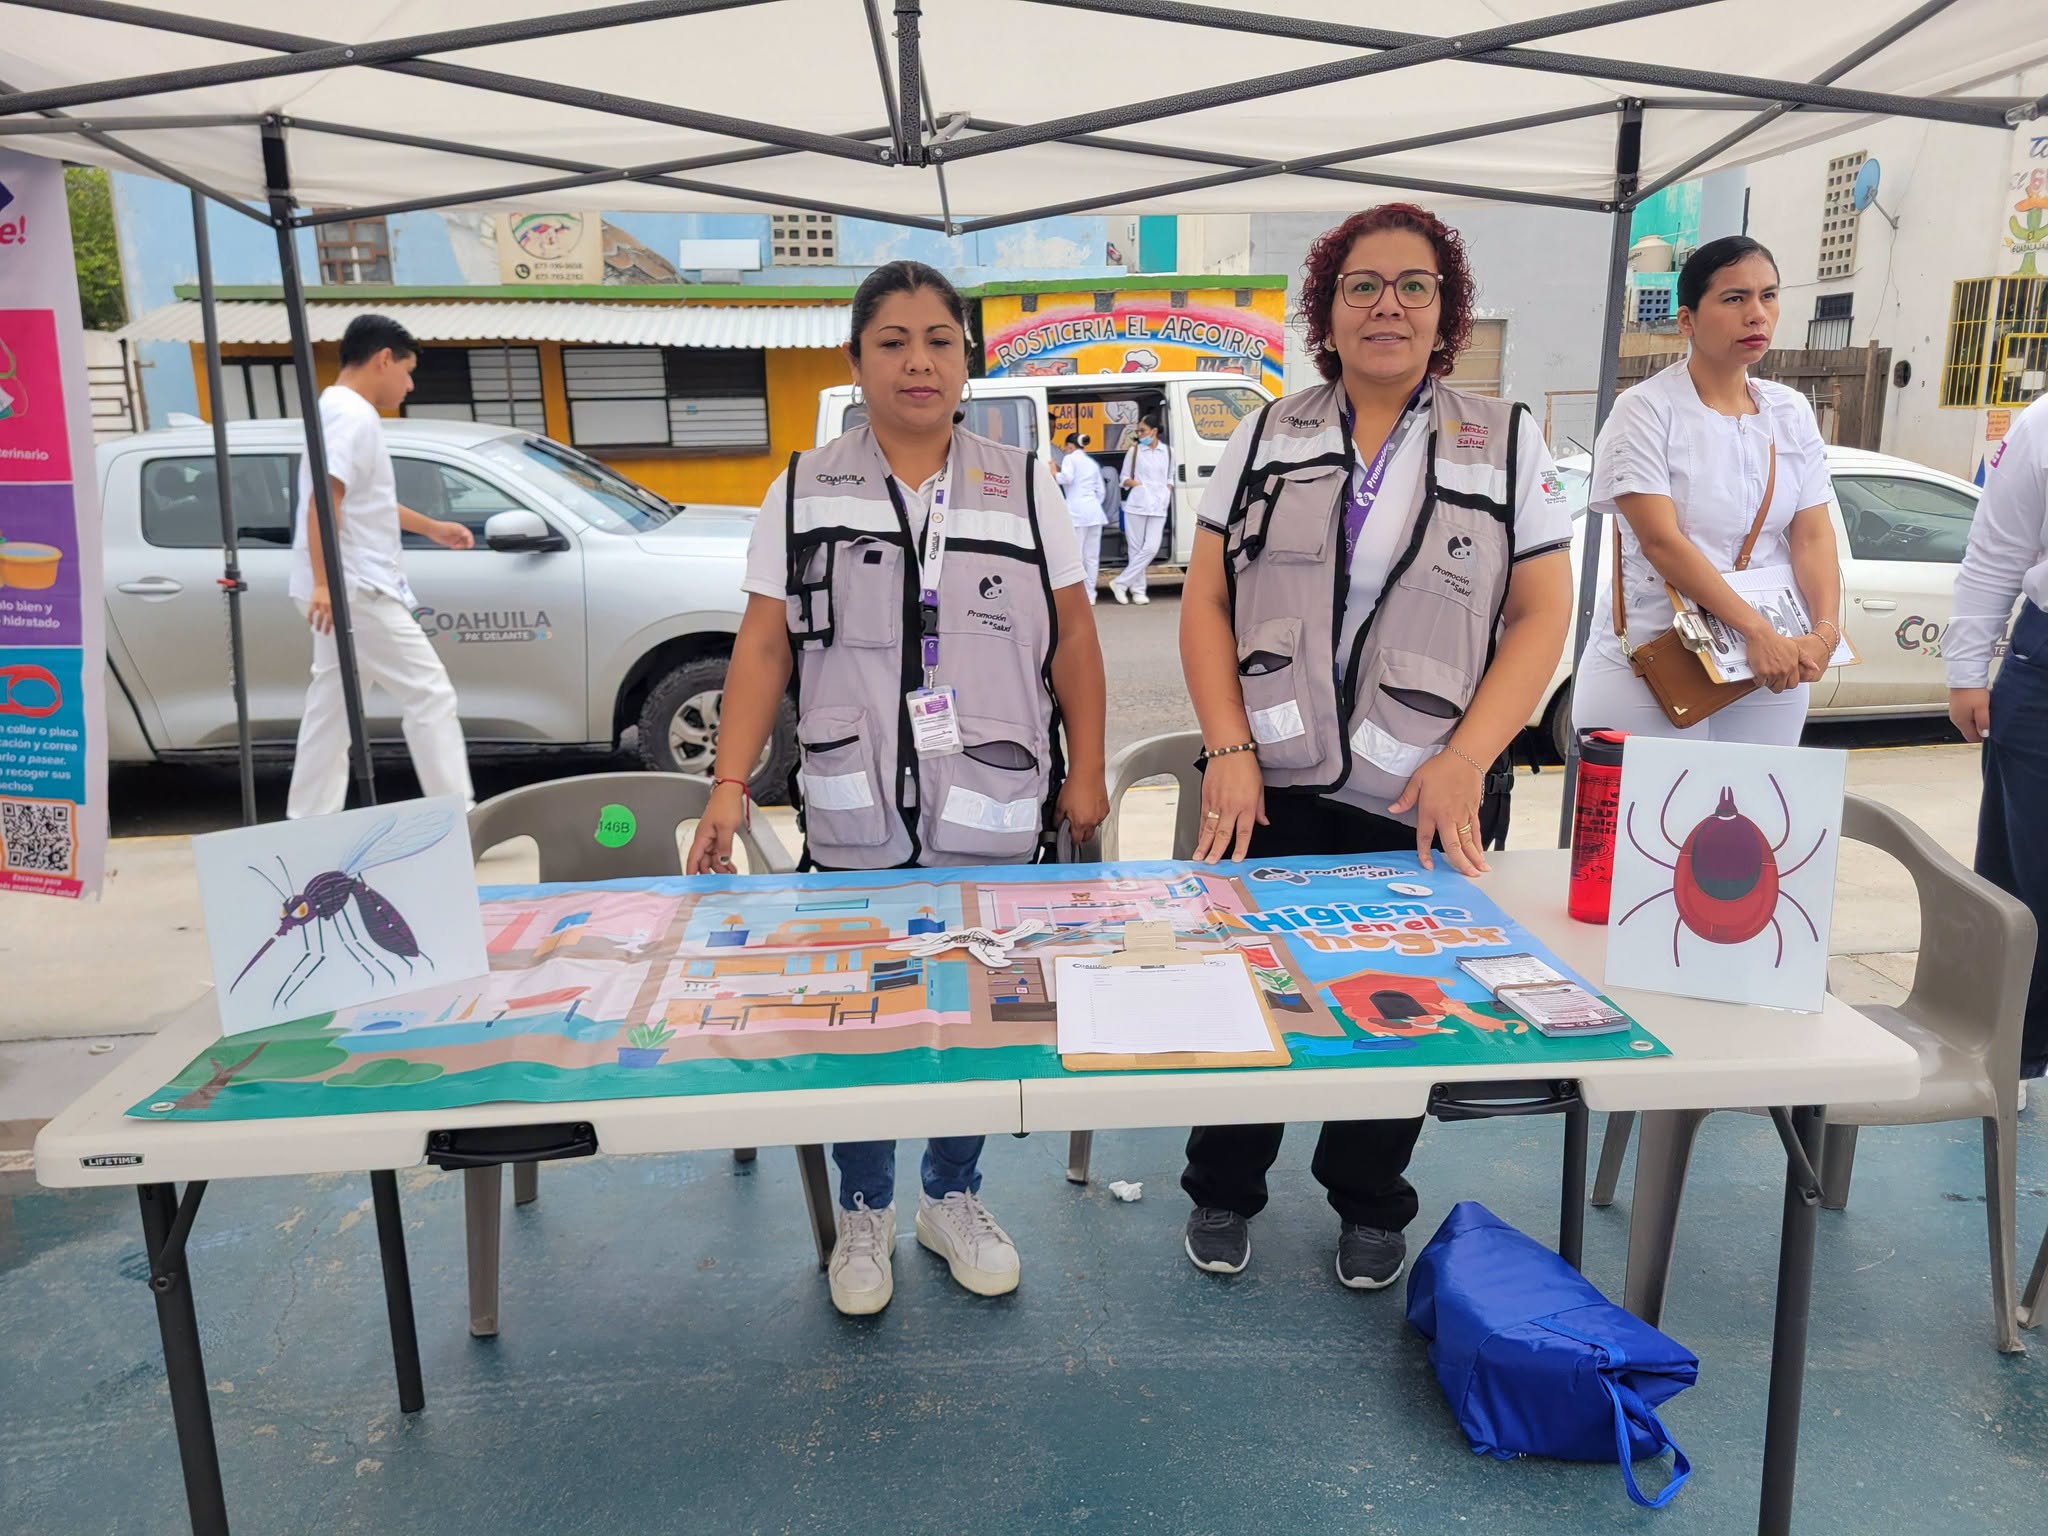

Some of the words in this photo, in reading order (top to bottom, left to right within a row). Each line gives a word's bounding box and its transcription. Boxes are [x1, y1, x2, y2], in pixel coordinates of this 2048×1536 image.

[997, 319, 1117, 367] ROSTICERIA
[1127, 316, 1149, 337] EL
[1160, 317, 1267, 359] ARCOIRIS
[1054, 405, 1094, 418] CARON
[1460, 425, 1489, 435] México
[1457, 438, 1485, 446] Salud
[0, 448, 49, 461] erinario
[1432, 564, 1470, 586] Promoción
[1453, 584, 1472, 597] Salud
[16, 601, 43, 612] bien
[45, 604, 53, 615] y
[3, 615, 60, 628] hidratado
[412, 607, 552, 637] COAHUILA
[967, 609, 1007, 622] Promoción
[992, 623, 1012, 632] Salud
[7, 723, 36, 734] collar
[39, 727, 47, 735] o
[49, 727, 78, 738] placa
[34, 741, 40, 751] y
[43, 742, 77, 751] correa
[28, 756, 66, 765] pasear.
[6, 768, 49, 780] recoger
[52, 771, 71, 779] sus
[1240, 903, 1467, 932] Higiene
[1351, 922, 1400, 933] en
[1404, 916, 1438, 930] el
[1300, 927, 1505, 954] hogar
[89, 1156, 138, 1166] LIFETIME
